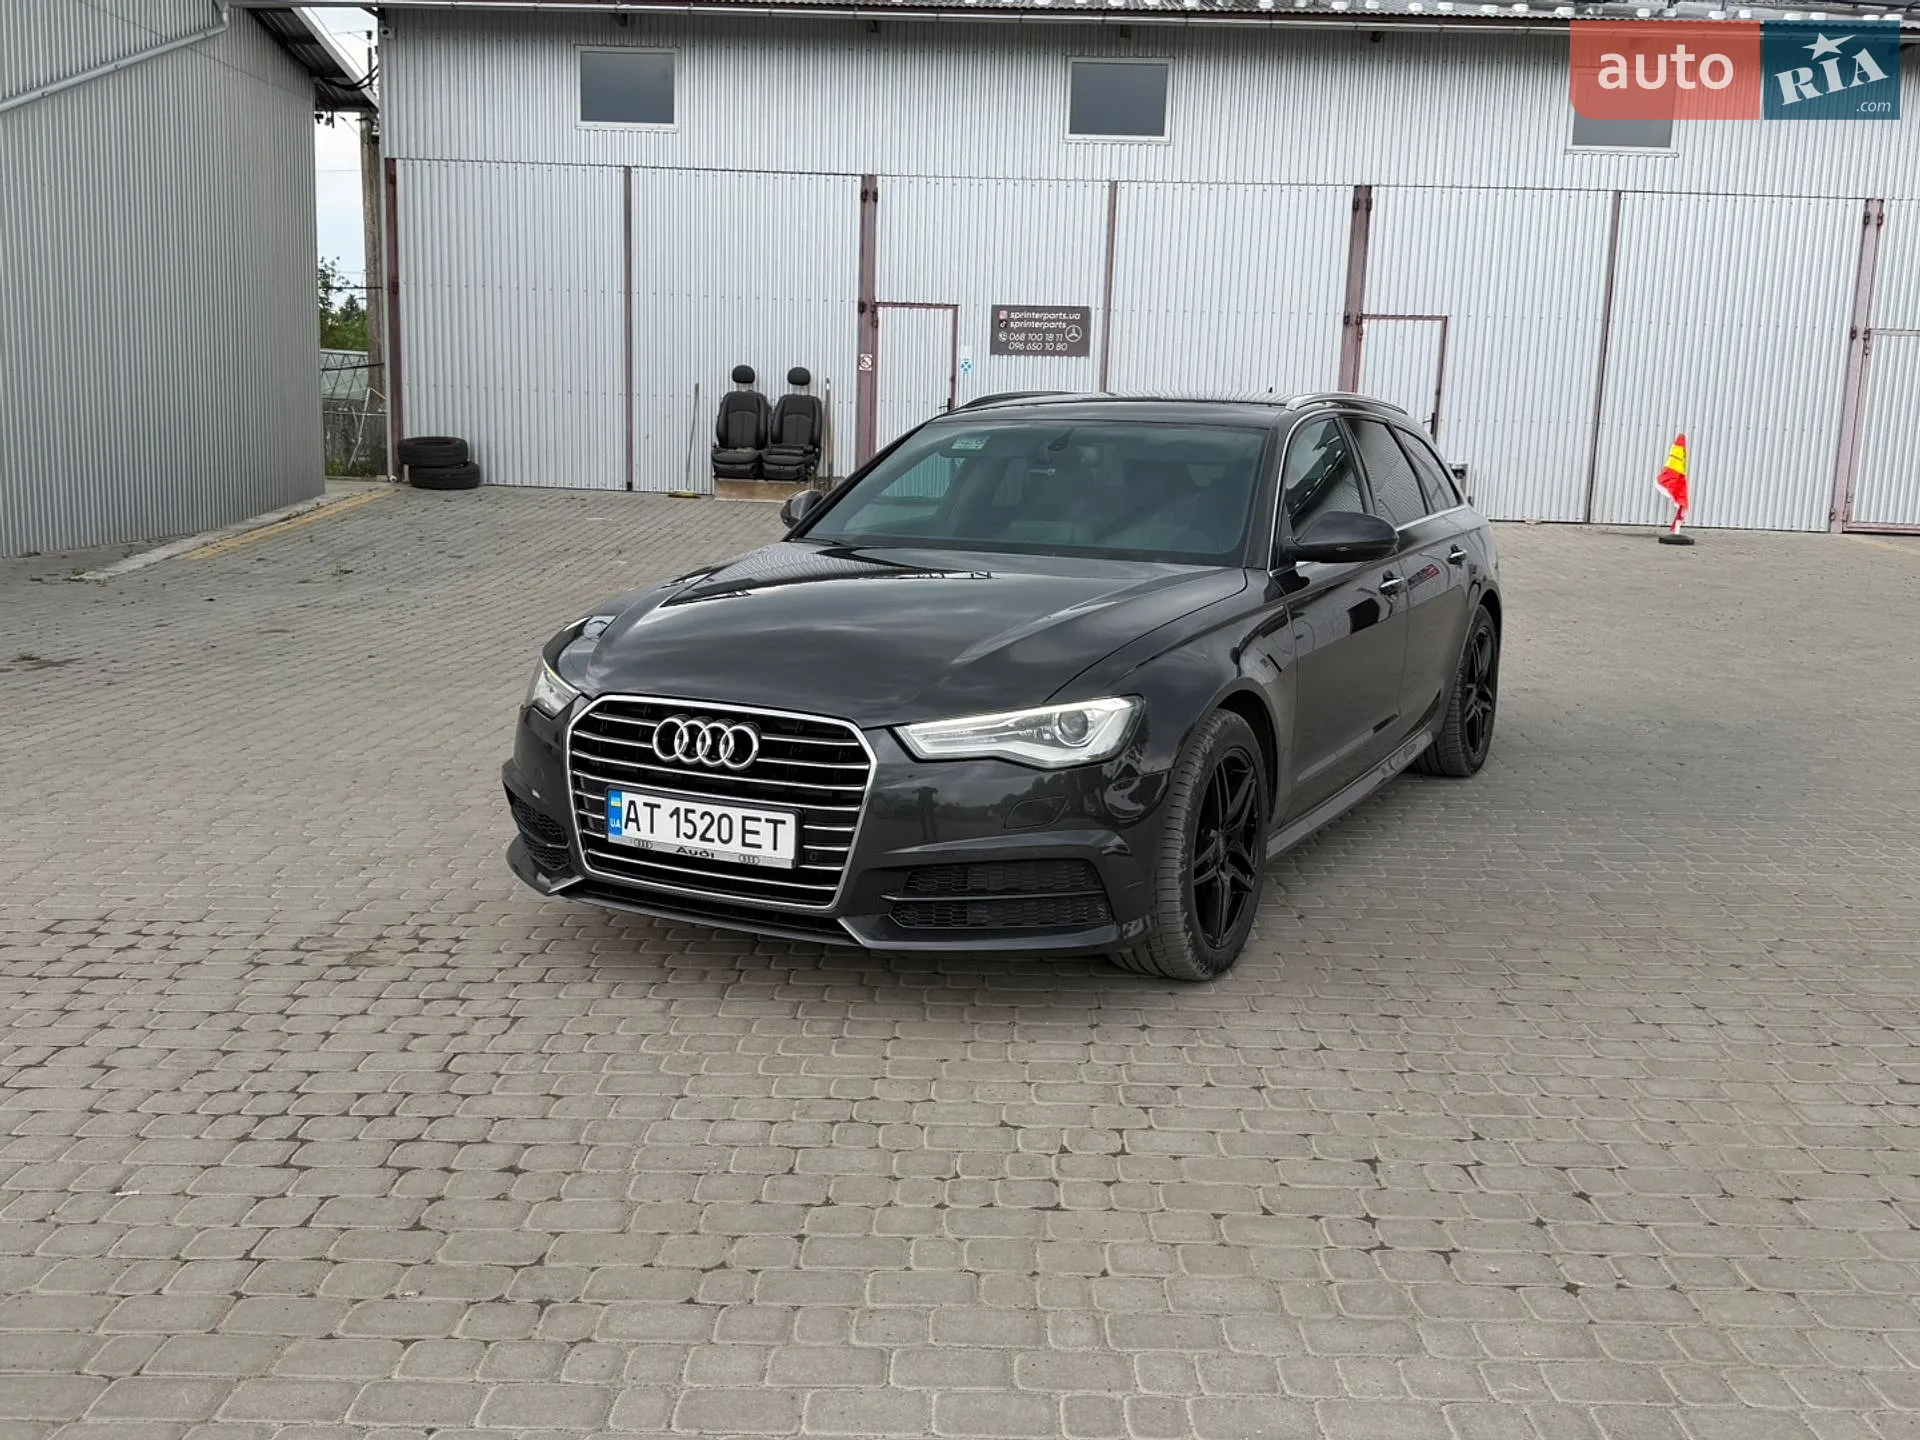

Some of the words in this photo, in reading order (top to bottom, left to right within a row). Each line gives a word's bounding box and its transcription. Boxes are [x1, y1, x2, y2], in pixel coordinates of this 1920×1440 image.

[1009, 310, 1081, 320] sprinterparts.ua
[1009, 320, 1067, 329] sprinterparts
[1009, 333, 1026, 342] 068
[1027, 333, 1043, 342] 100
[1008, 342, 1025, 351] 096
[1026, 342, 1043, 351] 650
[1045, 342, 1055, 351] 10
[610, 817, 621, 829] UA
[624, 800, 661, 834] AT
[669, 807, 733, 845] 1520
[741, 815, 786, 851] ET
[676, 846, 715, 859] Audi
